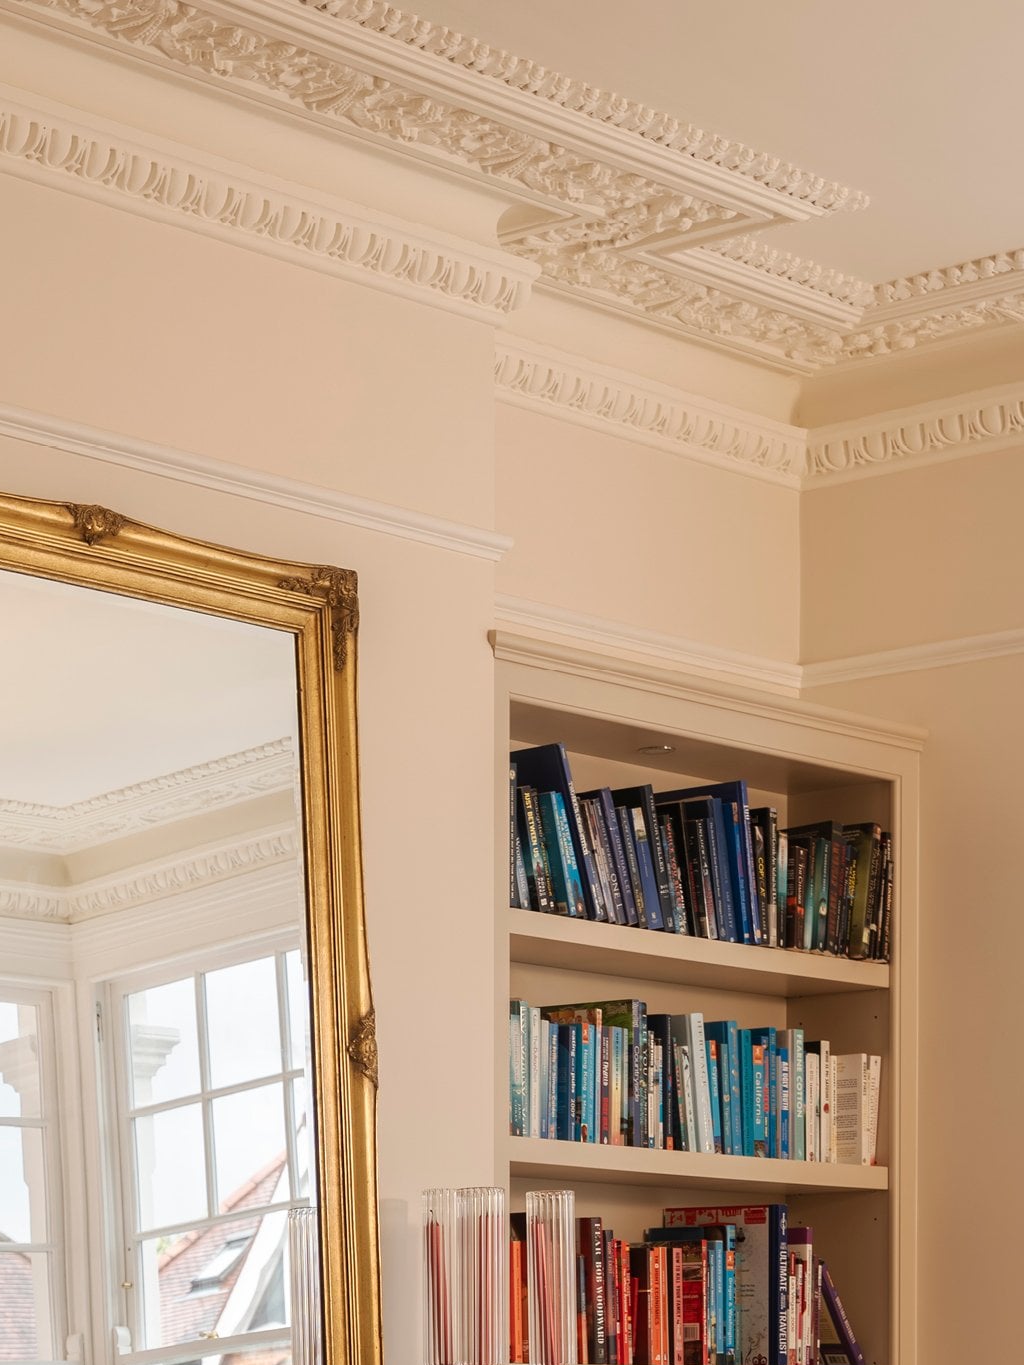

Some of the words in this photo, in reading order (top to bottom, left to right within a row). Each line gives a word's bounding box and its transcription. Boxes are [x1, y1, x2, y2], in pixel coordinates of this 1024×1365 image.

[523, 791, 532, 809] JUST
[526, 811, 537, 846] BETWEEN
[666, 822, 675, 854] WHILE
[515, 836, 523, 867] Wrong
[533, 847, 540, 858] US
[614, 834, 627, 877] JONATHAN
[623, 879, 631, 894] LEE
[518, 867, 528, 893] Sister
[610, 873, 620, 899] ONE
[616, 901, 623, 911] L
[757, 857, 766, 898] COPYCAT
[569, 1029, 577, 1057] eating
[581, 1048, 589, 1070] Hong
[796, 1034, 804, 1072] FEARNE
[569, 1072, 577, 1093] pubs
[581, 1070, 589, 1091] Kong
[632, 1045, 640, 1103] Countryside
[711, 1065, 719, 1097] Cyprus
[781, 1061, 789, 1072] AN
[781, 1072, 789, 1089] UGLY
[755, 1071, 763, 1125] California
[796, 1075, 804, 1118] COTTON
[594, 1223, 604, 1255] FEAR
[595, 1261, 604, 1283] BOB
[779, 1250, 788, 1292] ULTIMATE
[726, 1277, 734, 1301] Oregon
[595, 1285, 606, 1345] WOODWARD
[726, 1308, 734, 1345] Washington
[779, 1310, 788, 1355] TRAVELIST
